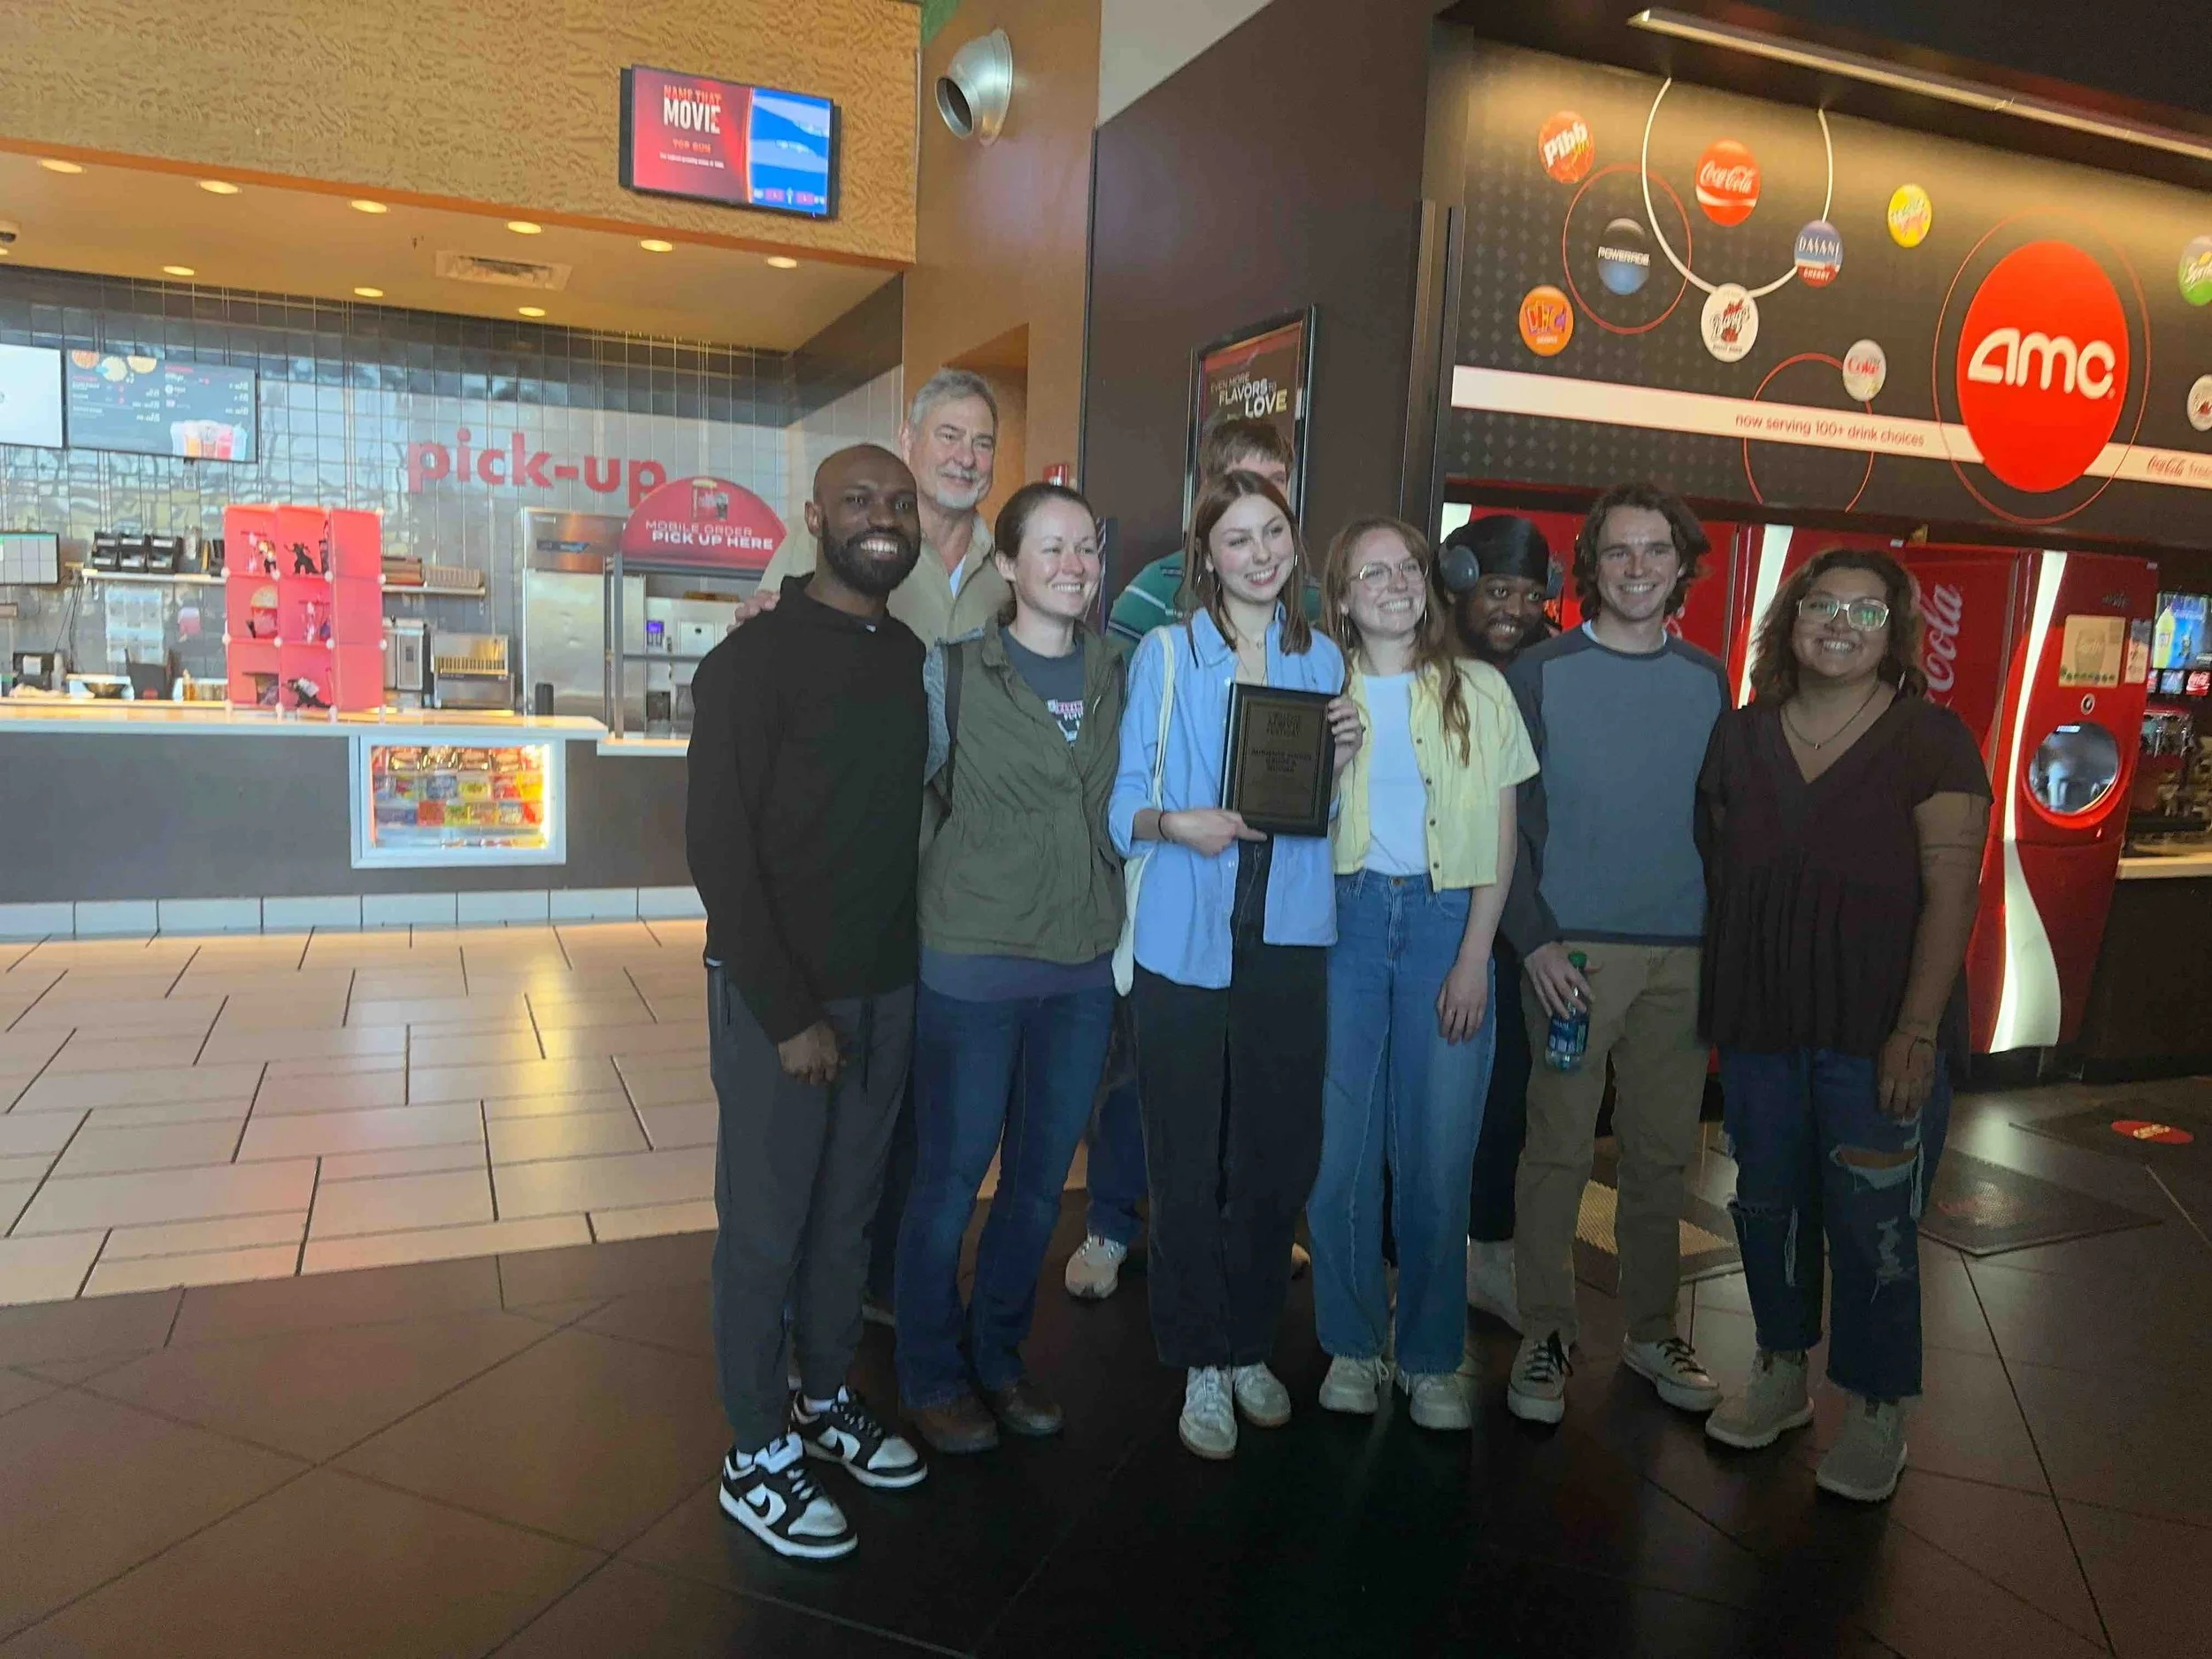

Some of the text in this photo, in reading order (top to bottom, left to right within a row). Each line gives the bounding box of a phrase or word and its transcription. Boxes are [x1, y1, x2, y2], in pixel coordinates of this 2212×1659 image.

[695, 89, 722, 105] THAT
[664, 96, 721, 134] MOVIE
[1700, 160, 1755, 194] Coca-Cola
[1597, 246, 1650, 266] POWERADE
[1799, 235, 1839, 265] DASANI
[1219, 378, 1268, 407] FLAVORS
[1245, 388, 1287, 419] LOVE
[1735, 414, 1925, 448] now serving 100+ drink choices
[408, 427, 666, 508] pick-up
[2147, 455, 2185, 476] Coca-Cola
[646, 520, 752, 538] MOBILE ORDER
[652, 531, 772, 550] PICK UP HERE
